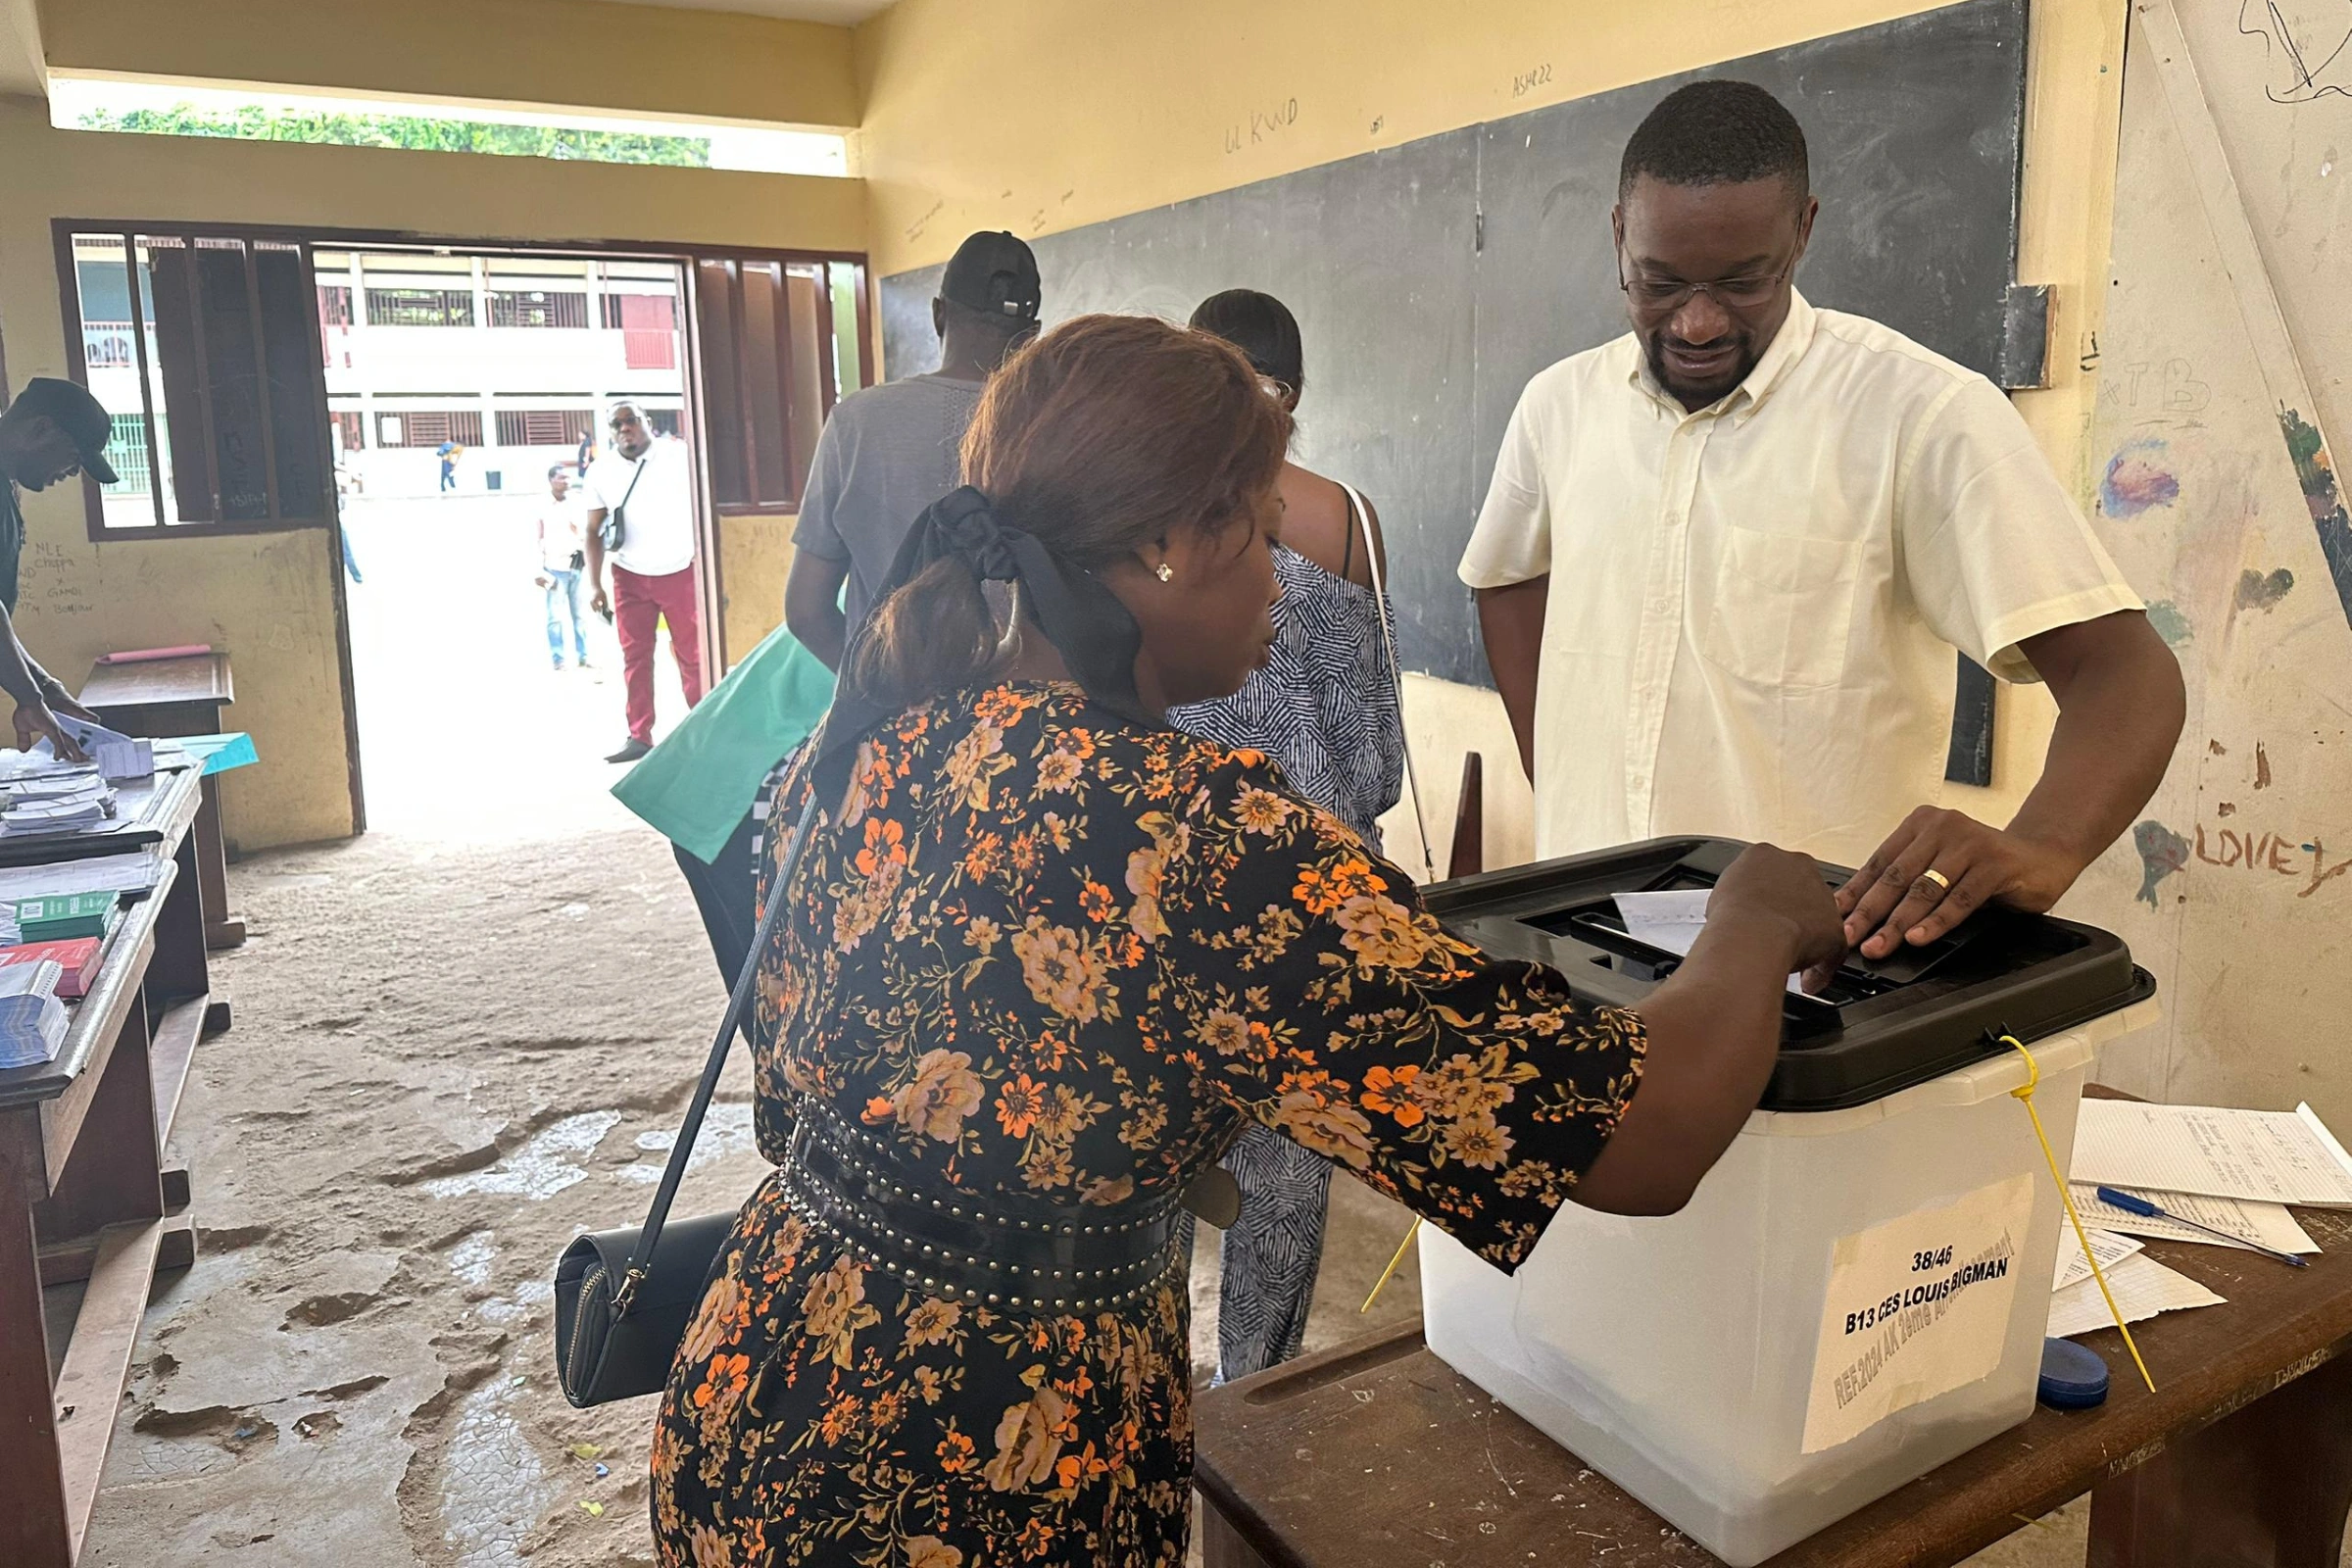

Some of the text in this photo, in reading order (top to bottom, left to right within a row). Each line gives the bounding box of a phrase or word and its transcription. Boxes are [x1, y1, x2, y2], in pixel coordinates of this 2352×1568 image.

[1911, 1245, 1953, 1272] 38/46
[1844, 1257, 2008, 1335] B13 CES LOUIS BIGMAN
